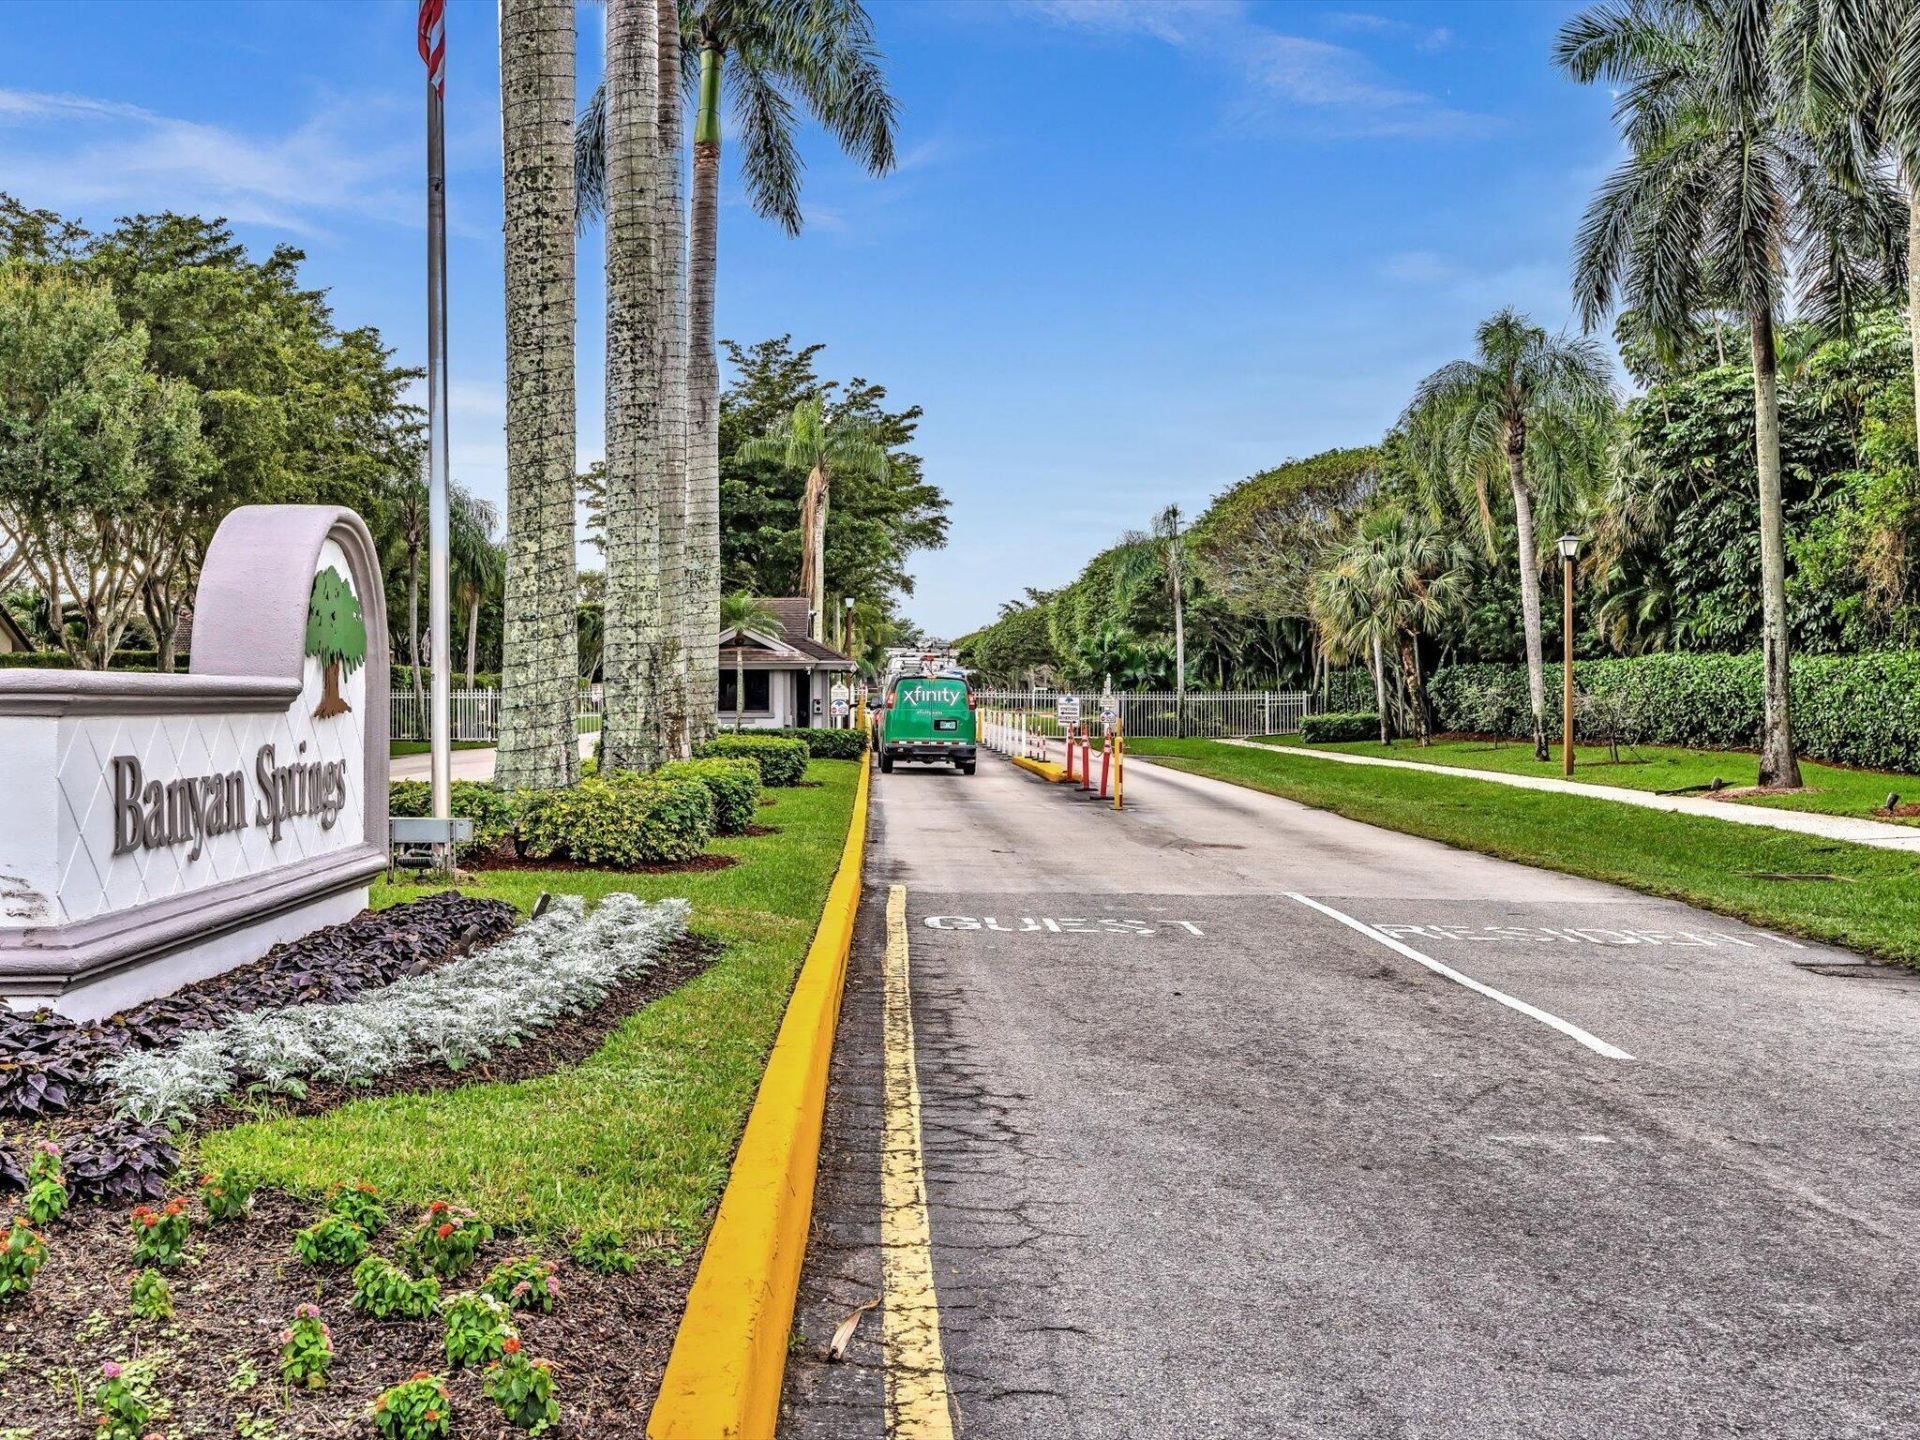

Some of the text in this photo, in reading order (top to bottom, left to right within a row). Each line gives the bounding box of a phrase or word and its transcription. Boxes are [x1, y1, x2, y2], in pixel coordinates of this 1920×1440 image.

[904, 685, 960, 706] xfinity
[112, 740, 347, 862] Banyan Springs
[923, 915, 1206, 936] GUEST
[1372, 923, 1809, 949] RESIDENT
